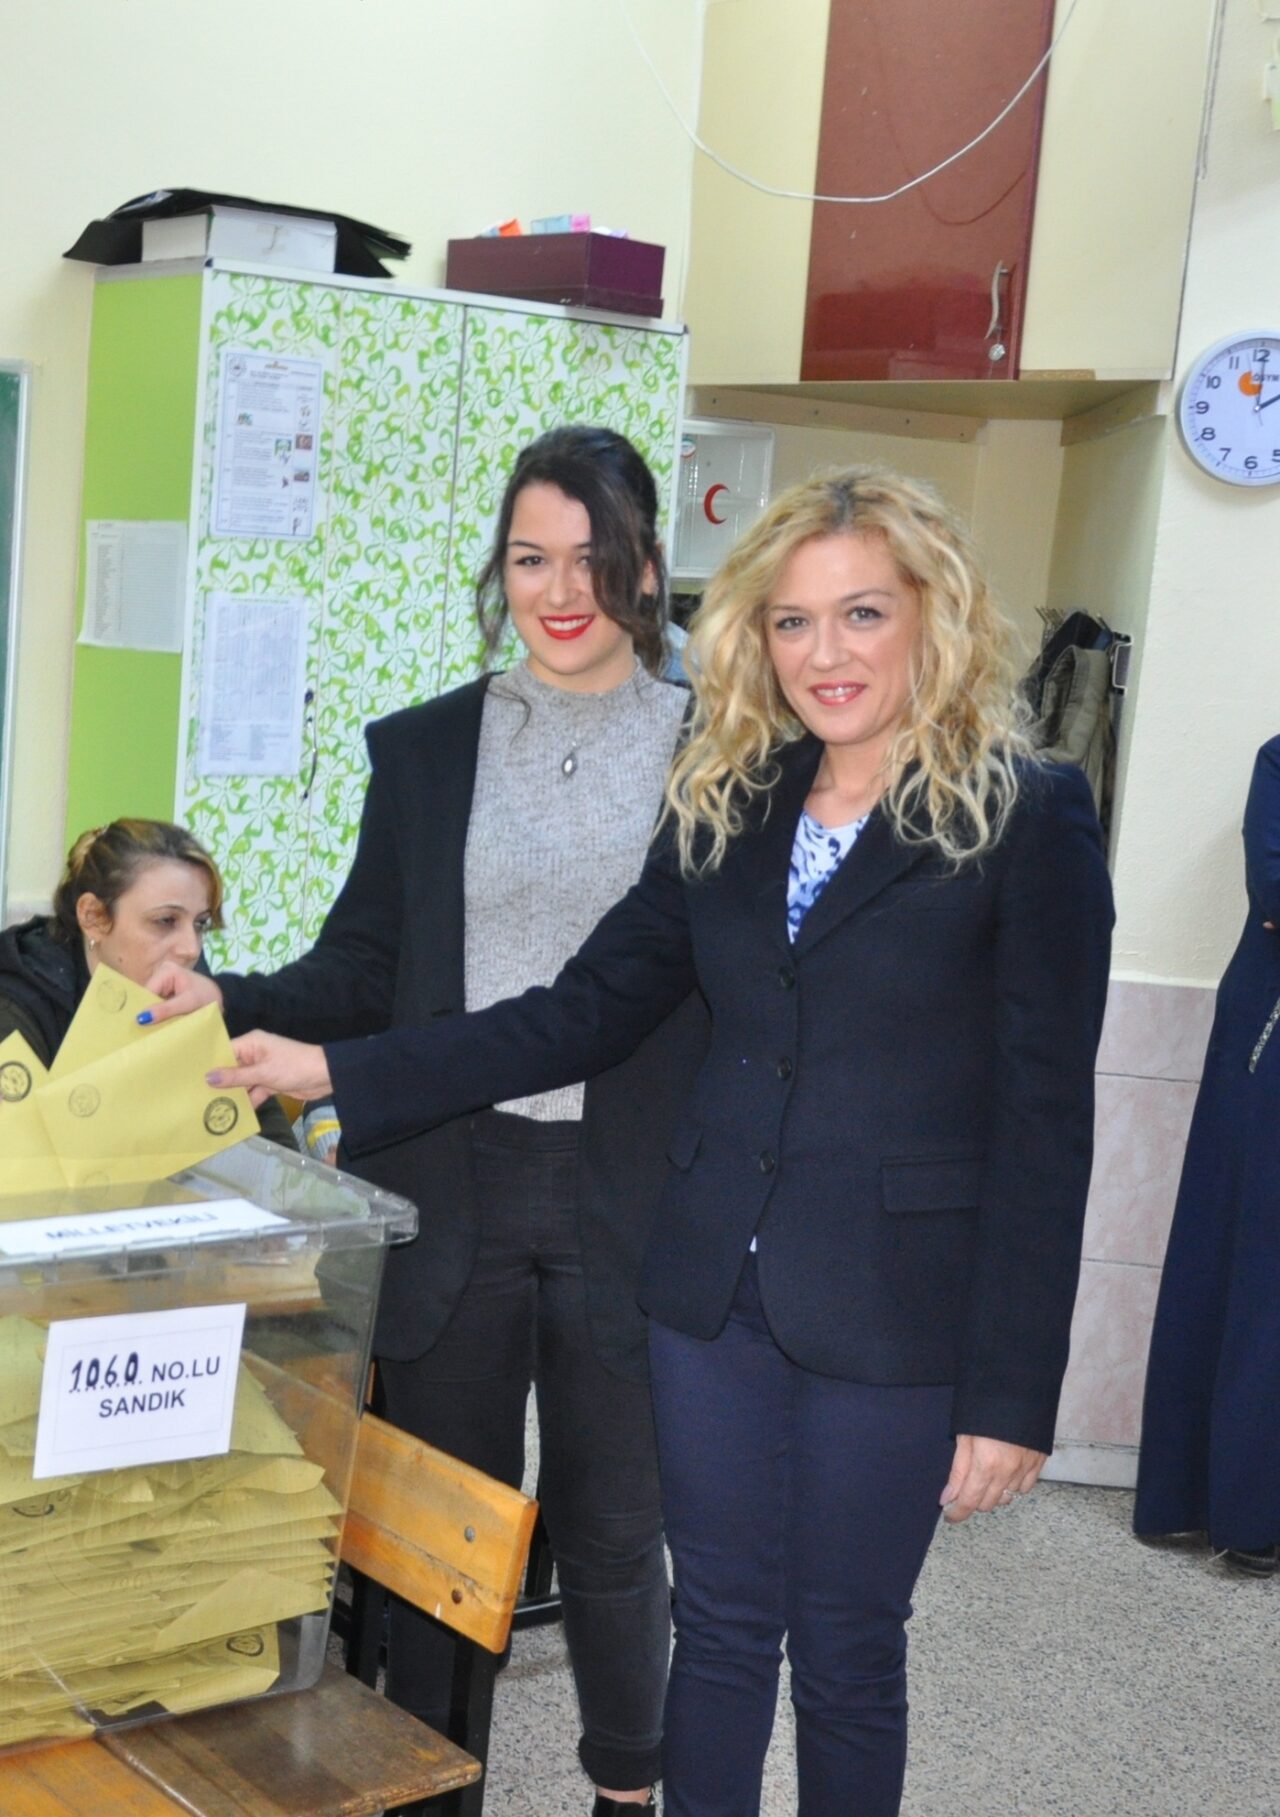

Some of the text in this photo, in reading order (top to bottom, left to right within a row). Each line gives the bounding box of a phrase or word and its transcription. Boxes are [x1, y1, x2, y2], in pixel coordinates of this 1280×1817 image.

[1228, 356, 1240, 370] 11
[1253, 349, 1270, 363] 12
[1206, 375, 1222, 389] 10
[1195, 401, 1210, 415] 9
[1200, 427, 1216, 441] 8
[1219, 447, 1232, 462] 7
[1244, 455, 1258, 470] 6
[151, 1355, 221, 1383] NO.LU
[98, 1389, 187, 1419] SANDIK
